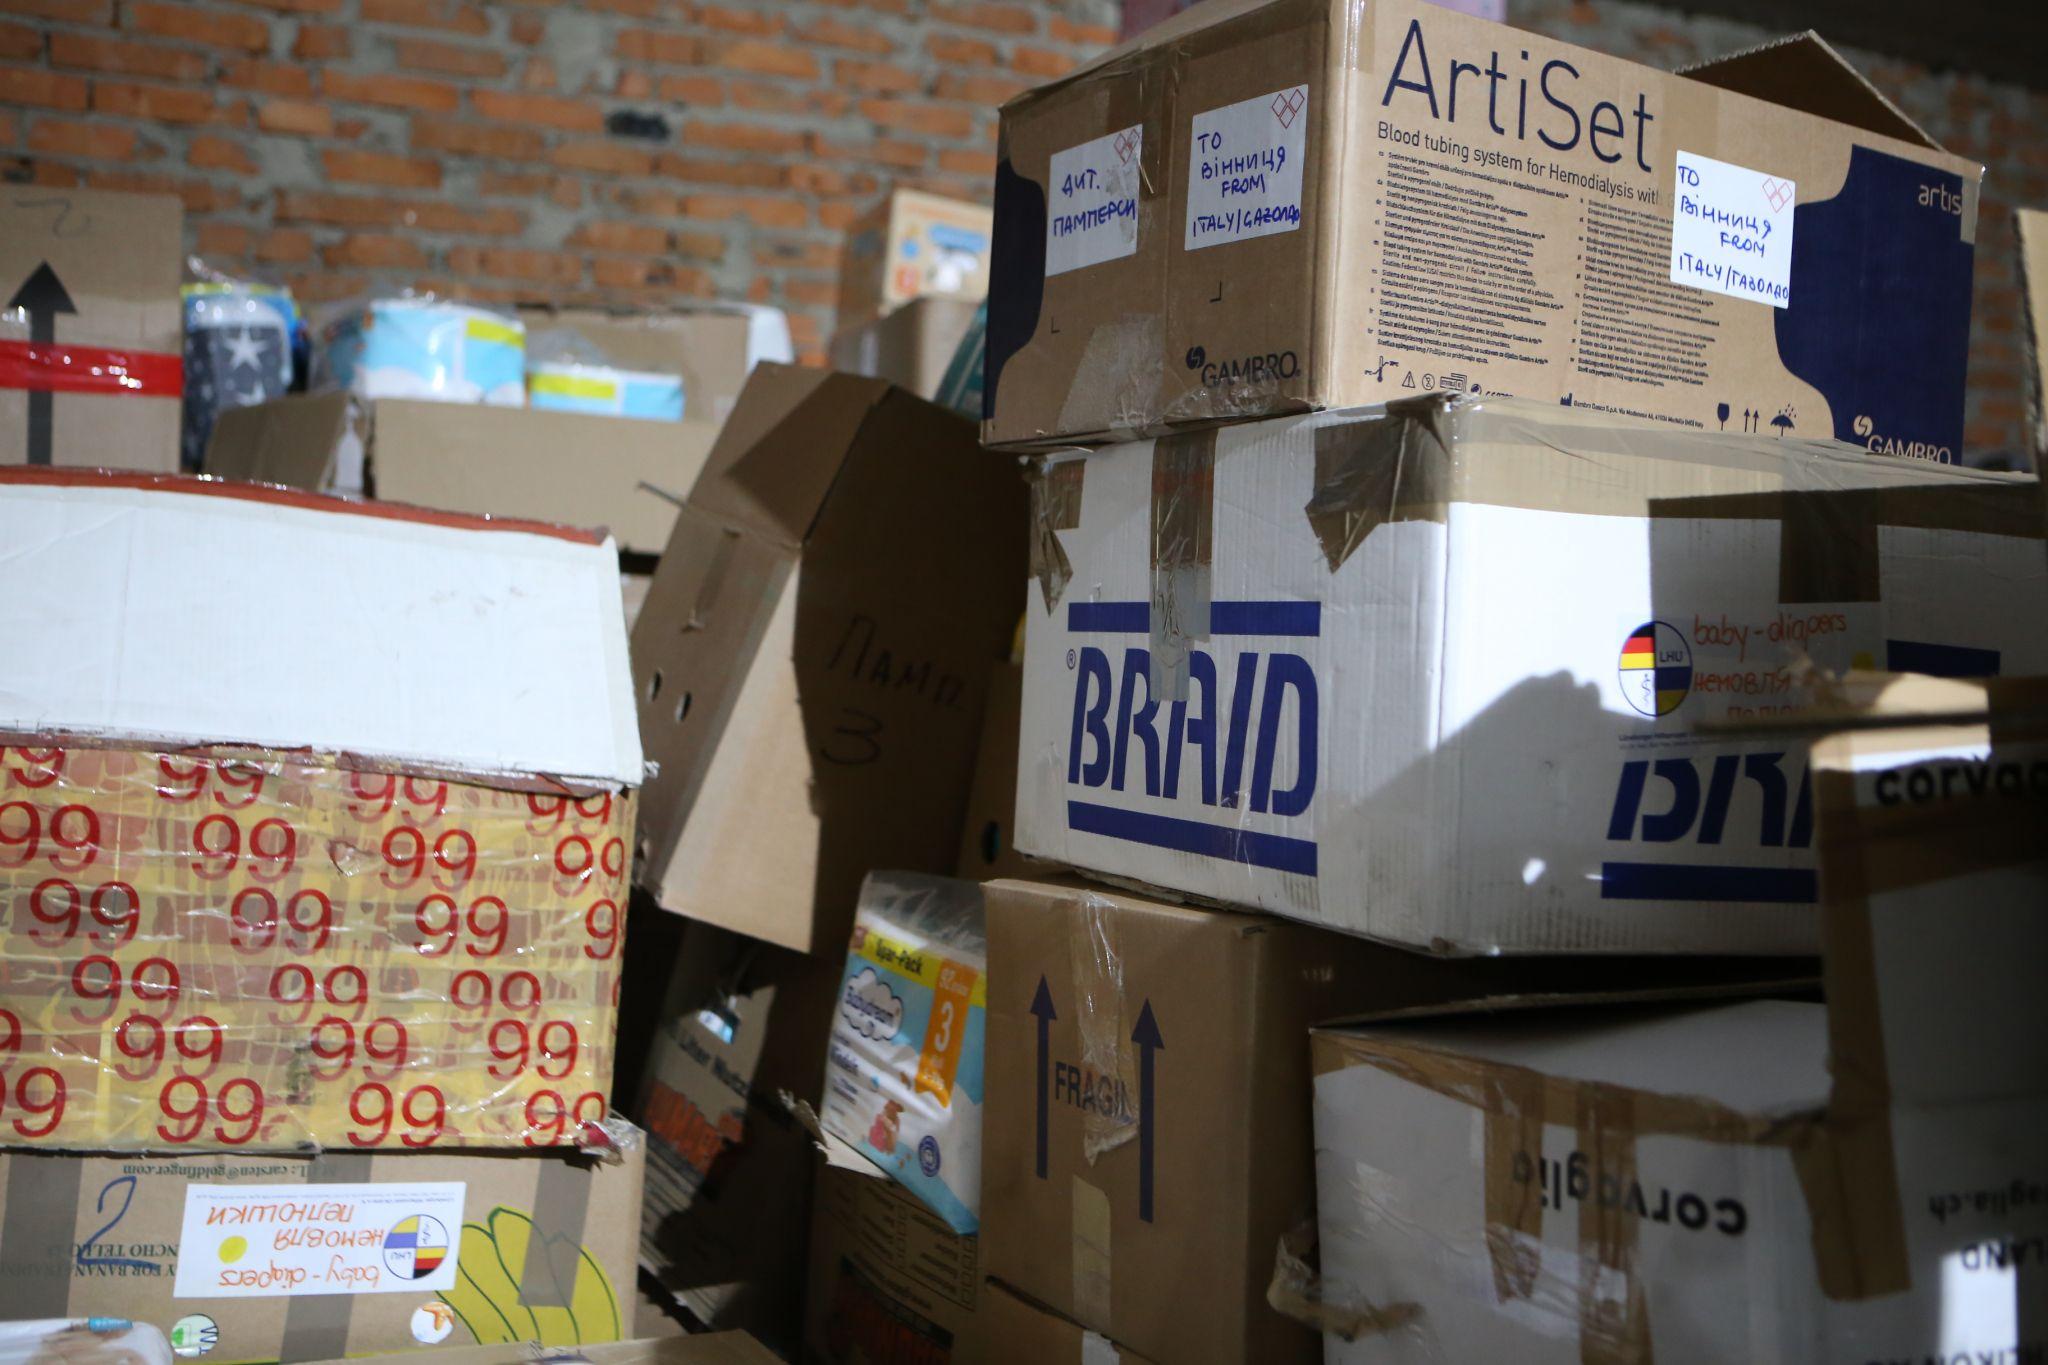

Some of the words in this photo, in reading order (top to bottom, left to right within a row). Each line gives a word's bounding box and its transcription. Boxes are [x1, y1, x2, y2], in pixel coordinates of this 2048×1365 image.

[1381, 19, 1654, 172] ArtiSet
[1198, 132, 1222, 154] TO
[1377, 120, 1420, 147] Blood
[1425, 133, 1469, 158] tubing
[1474, 147, 1523, 171] system
[1527, 157, 1546, 177] for
[1550, 165, 1634, 199] Hemodialysis
[1221, 174, 1266, 198] FROM
[1678, 165, 1700, 187] TO
[1918, 183, 1963, 215] artis
[1719, 231, 1765, 258] FROM
[1867, 434, 1951, 465] GAMBRO
[1694, 614, 1748, 662] baby
[1660, 650, 1684, 663] LHU
[192, 814, 296, 884] 99
[380, 825, 476, 893] 99
[28, 878, 140, 950] 99
[231, 887, 332, 955] 99
[414, 894, 509, 958] 99
[70, 954, 180, 1025] 99
[268, 963, 368, 1028] 99
[450, 970, 541, 1034] 99
[934, 1001, 954, 1053] 3
[115, 1014, 223, 1082] 99
[309, 1016, 408, 1082] 99
[487, 1019, 579, 1082] 99
[157, 1075, 265, 1145] 99
[347, 1082, 446, 1149] 99
[123, 1161, 288, 1181] carsten@goldfinger.com
[206, 1202, 354, 1226] пелюшки
[1929, 1178, 2048, 1227] aglia.ch
[274, 1228, 385, 1251] немовля
[218, 1259, 306, 1289] diapers
[325, 1255, 380, 1283] baby
